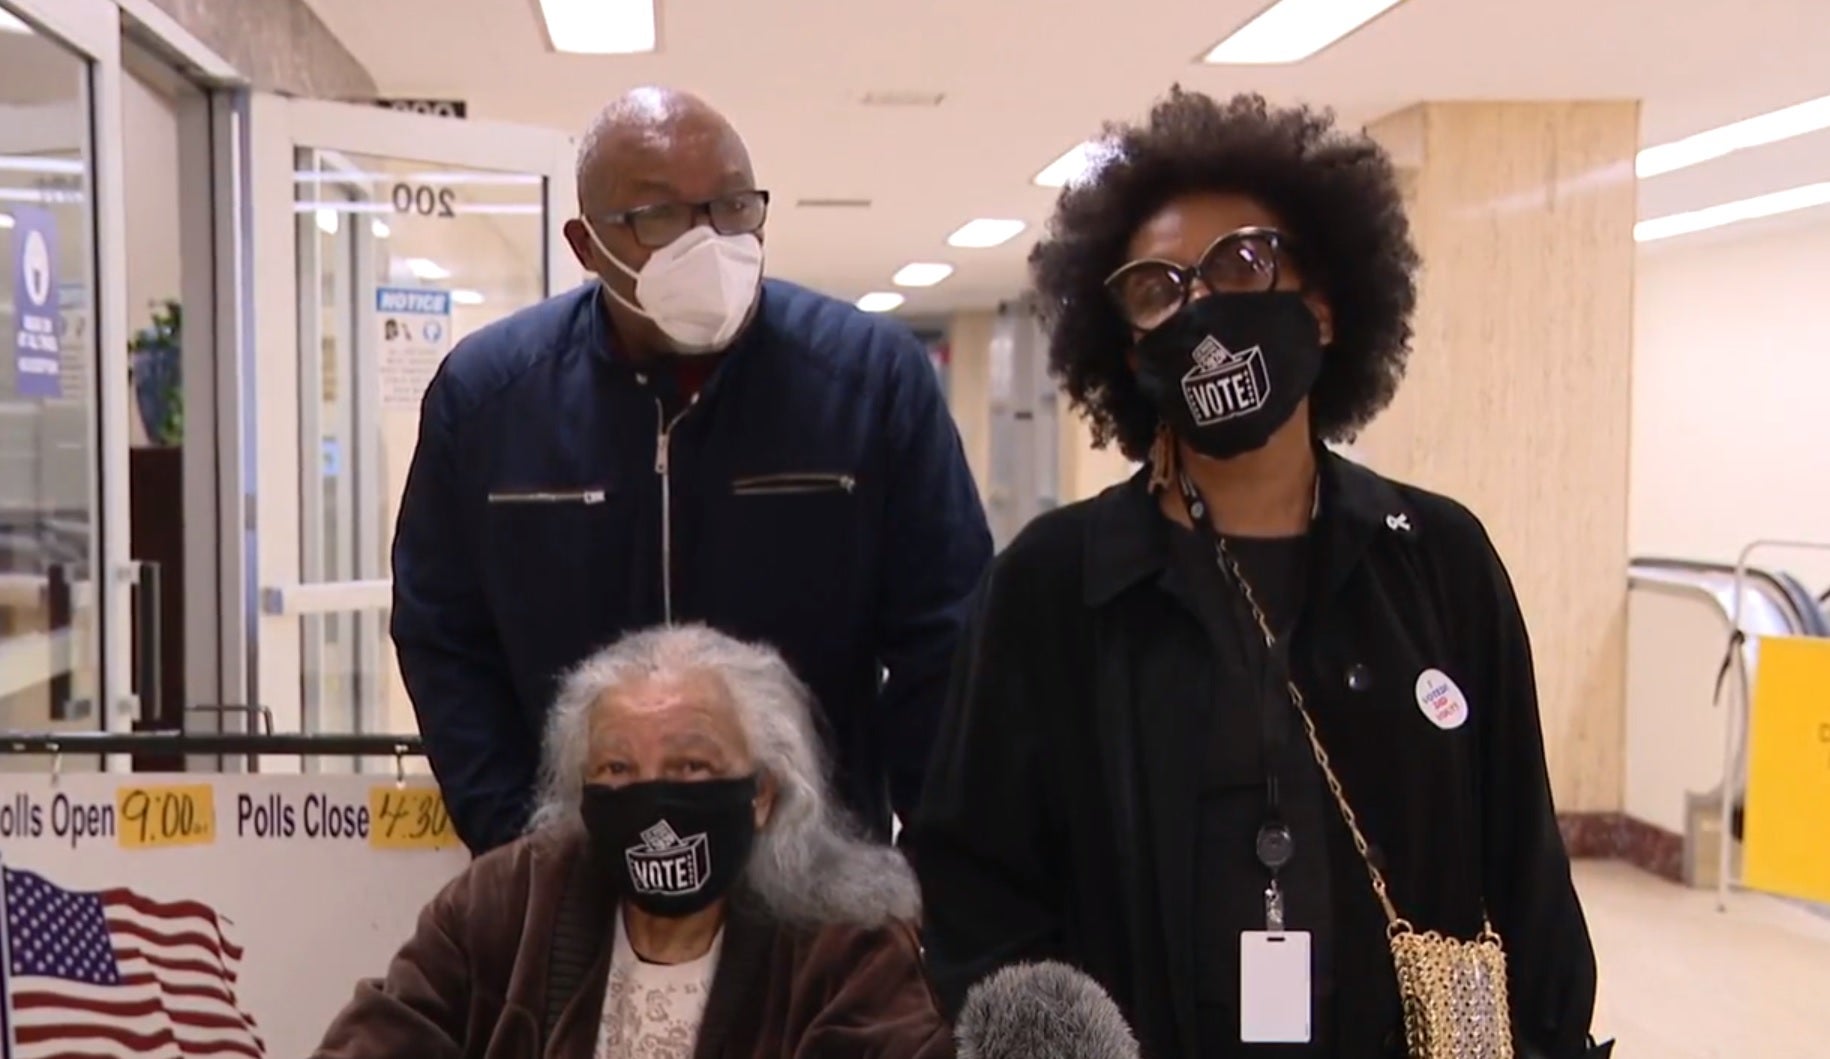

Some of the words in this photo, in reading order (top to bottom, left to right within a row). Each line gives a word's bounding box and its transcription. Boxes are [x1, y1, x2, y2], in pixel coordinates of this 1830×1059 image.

[380, 291, 446, 313] NOTICE
[1192, 373, 1249, 419] VOTE
[51, 793, 115, 849] Open
[237, 793, 295, 838] Polls
[303, 793, 370, 838] Close
[633, 857, 689, 890] VOTE
